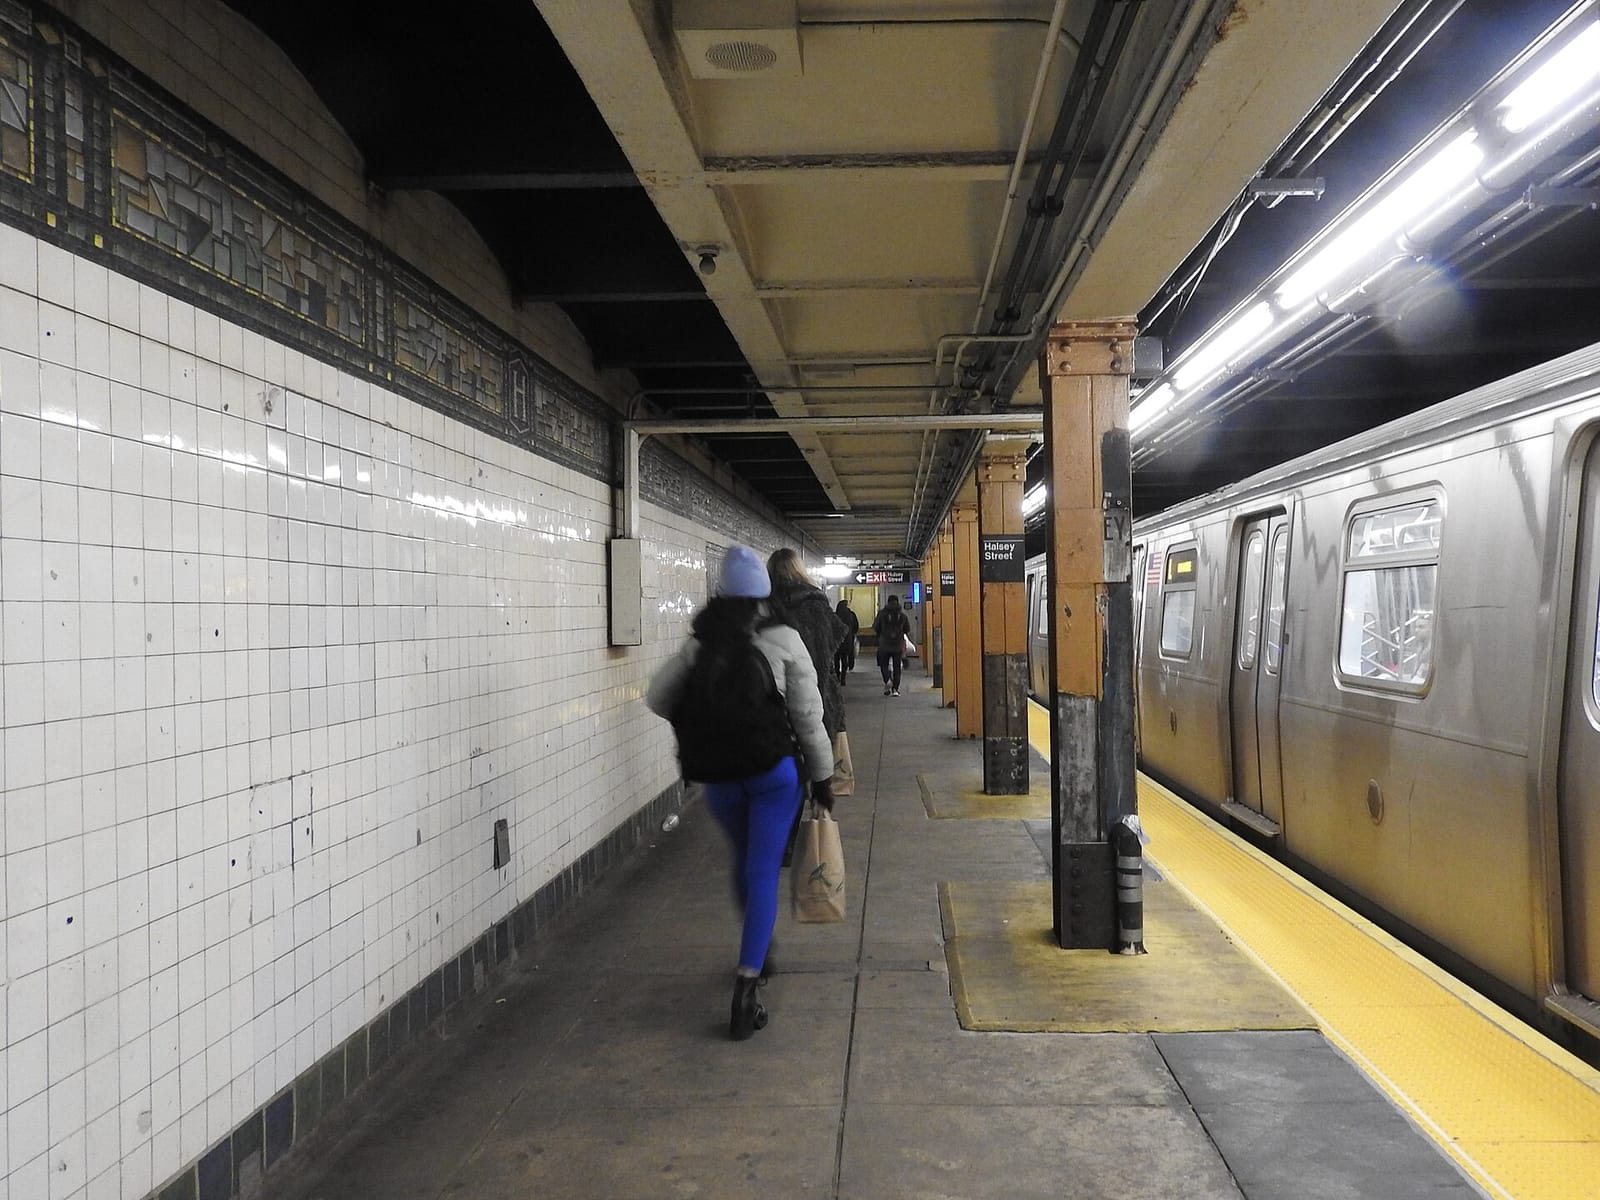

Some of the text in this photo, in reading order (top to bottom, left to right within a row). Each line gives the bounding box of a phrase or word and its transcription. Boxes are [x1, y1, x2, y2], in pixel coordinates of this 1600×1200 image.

[513, 370, 526, 422] H
[984, 542, 1015, 552] Halsey
[984, 552, 1013, 560] Street
[866, 572, 887, 582] Exit
